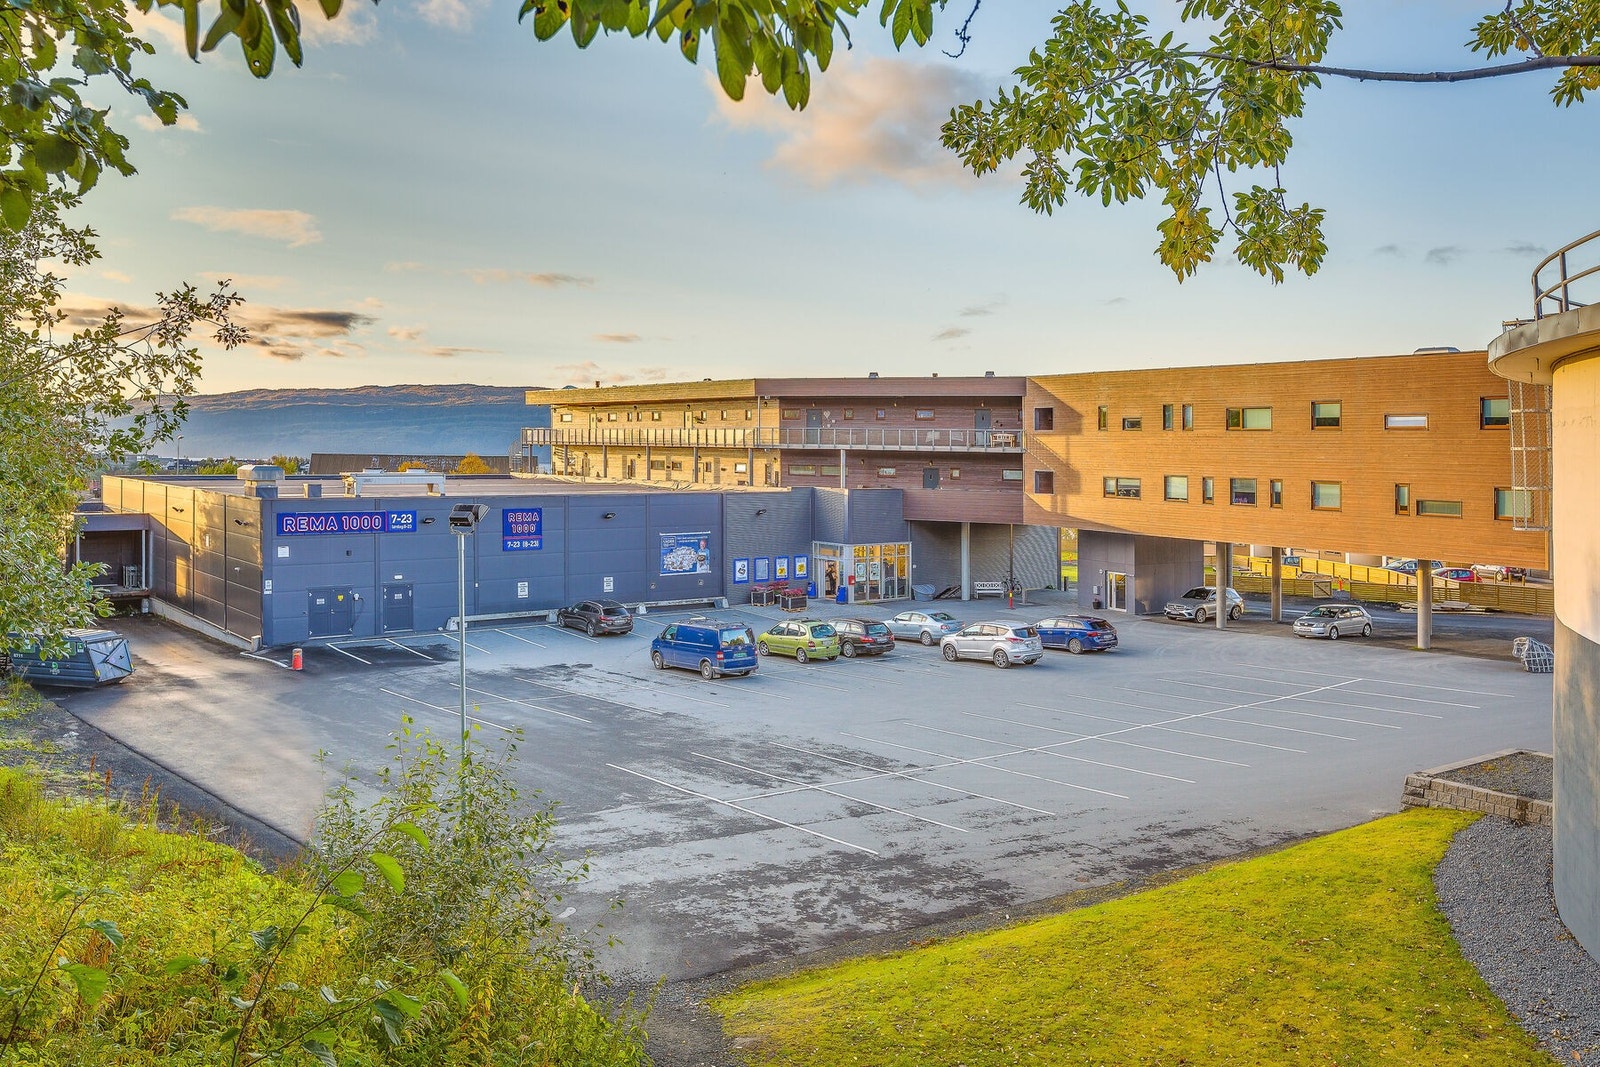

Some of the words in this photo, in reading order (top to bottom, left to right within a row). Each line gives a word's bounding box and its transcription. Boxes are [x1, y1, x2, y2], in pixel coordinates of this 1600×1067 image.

[391, 513, 412, 524] 7-23
[508, 512, 539, 522] REMA
[283, 516, 338, 532] REMA
[341, 515, 382, 530] 1000
[512, 523, 536, 533] 1000
